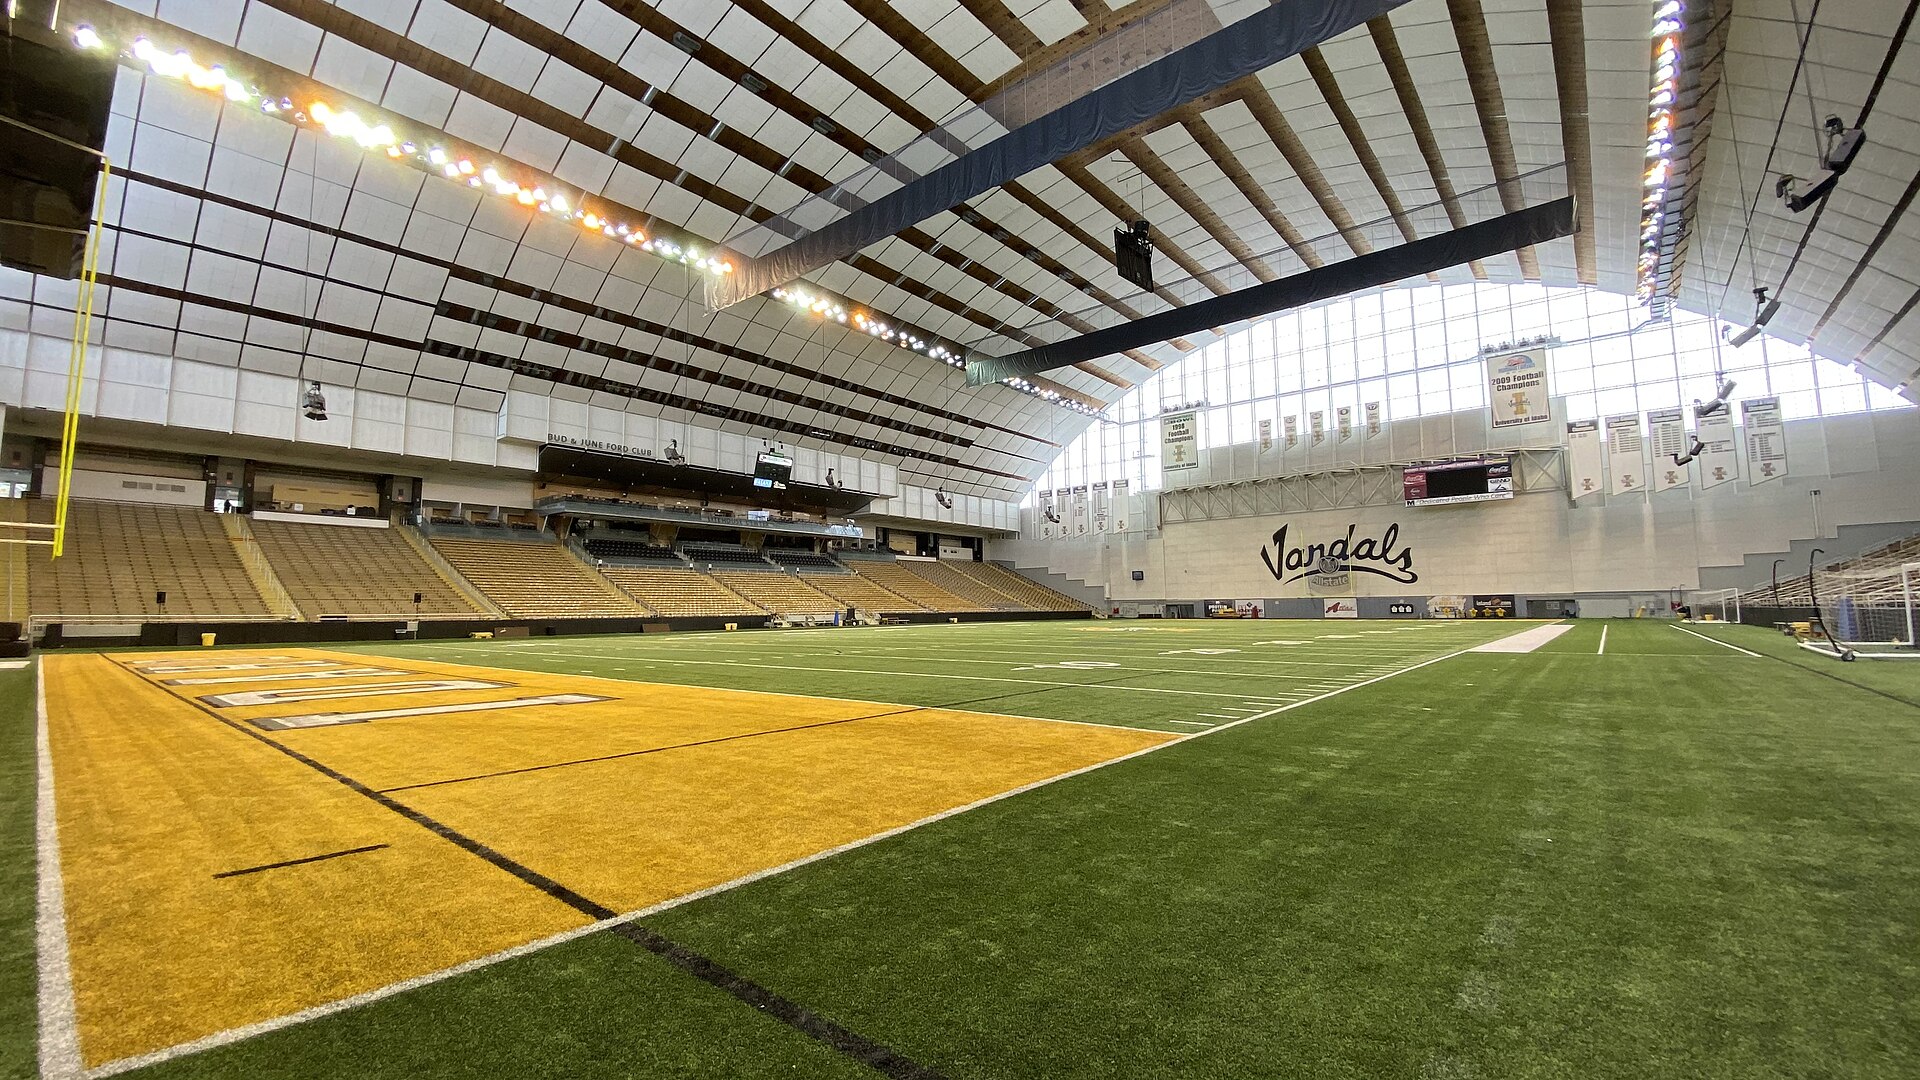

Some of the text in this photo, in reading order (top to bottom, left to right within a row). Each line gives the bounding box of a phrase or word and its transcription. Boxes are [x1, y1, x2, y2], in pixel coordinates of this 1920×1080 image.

[1492, 371, 1544, 386] 2009 Football
[1497, 380, 1540, 392] Champions
[1495, 418, 1523, 426] University
[1168, 429, 1189, 437] Football
[548, 433, 568, 443] BUD
[581, 438, 603, 449] JUNE
[606, 442, 629, 453] FORD
[631, 447, 652, 456] CLUB
[1451, 495, 1472, 503] People
[1260, 523, 1418, 585] Vandals
[1311, 575, 1349, 587] Allstate
